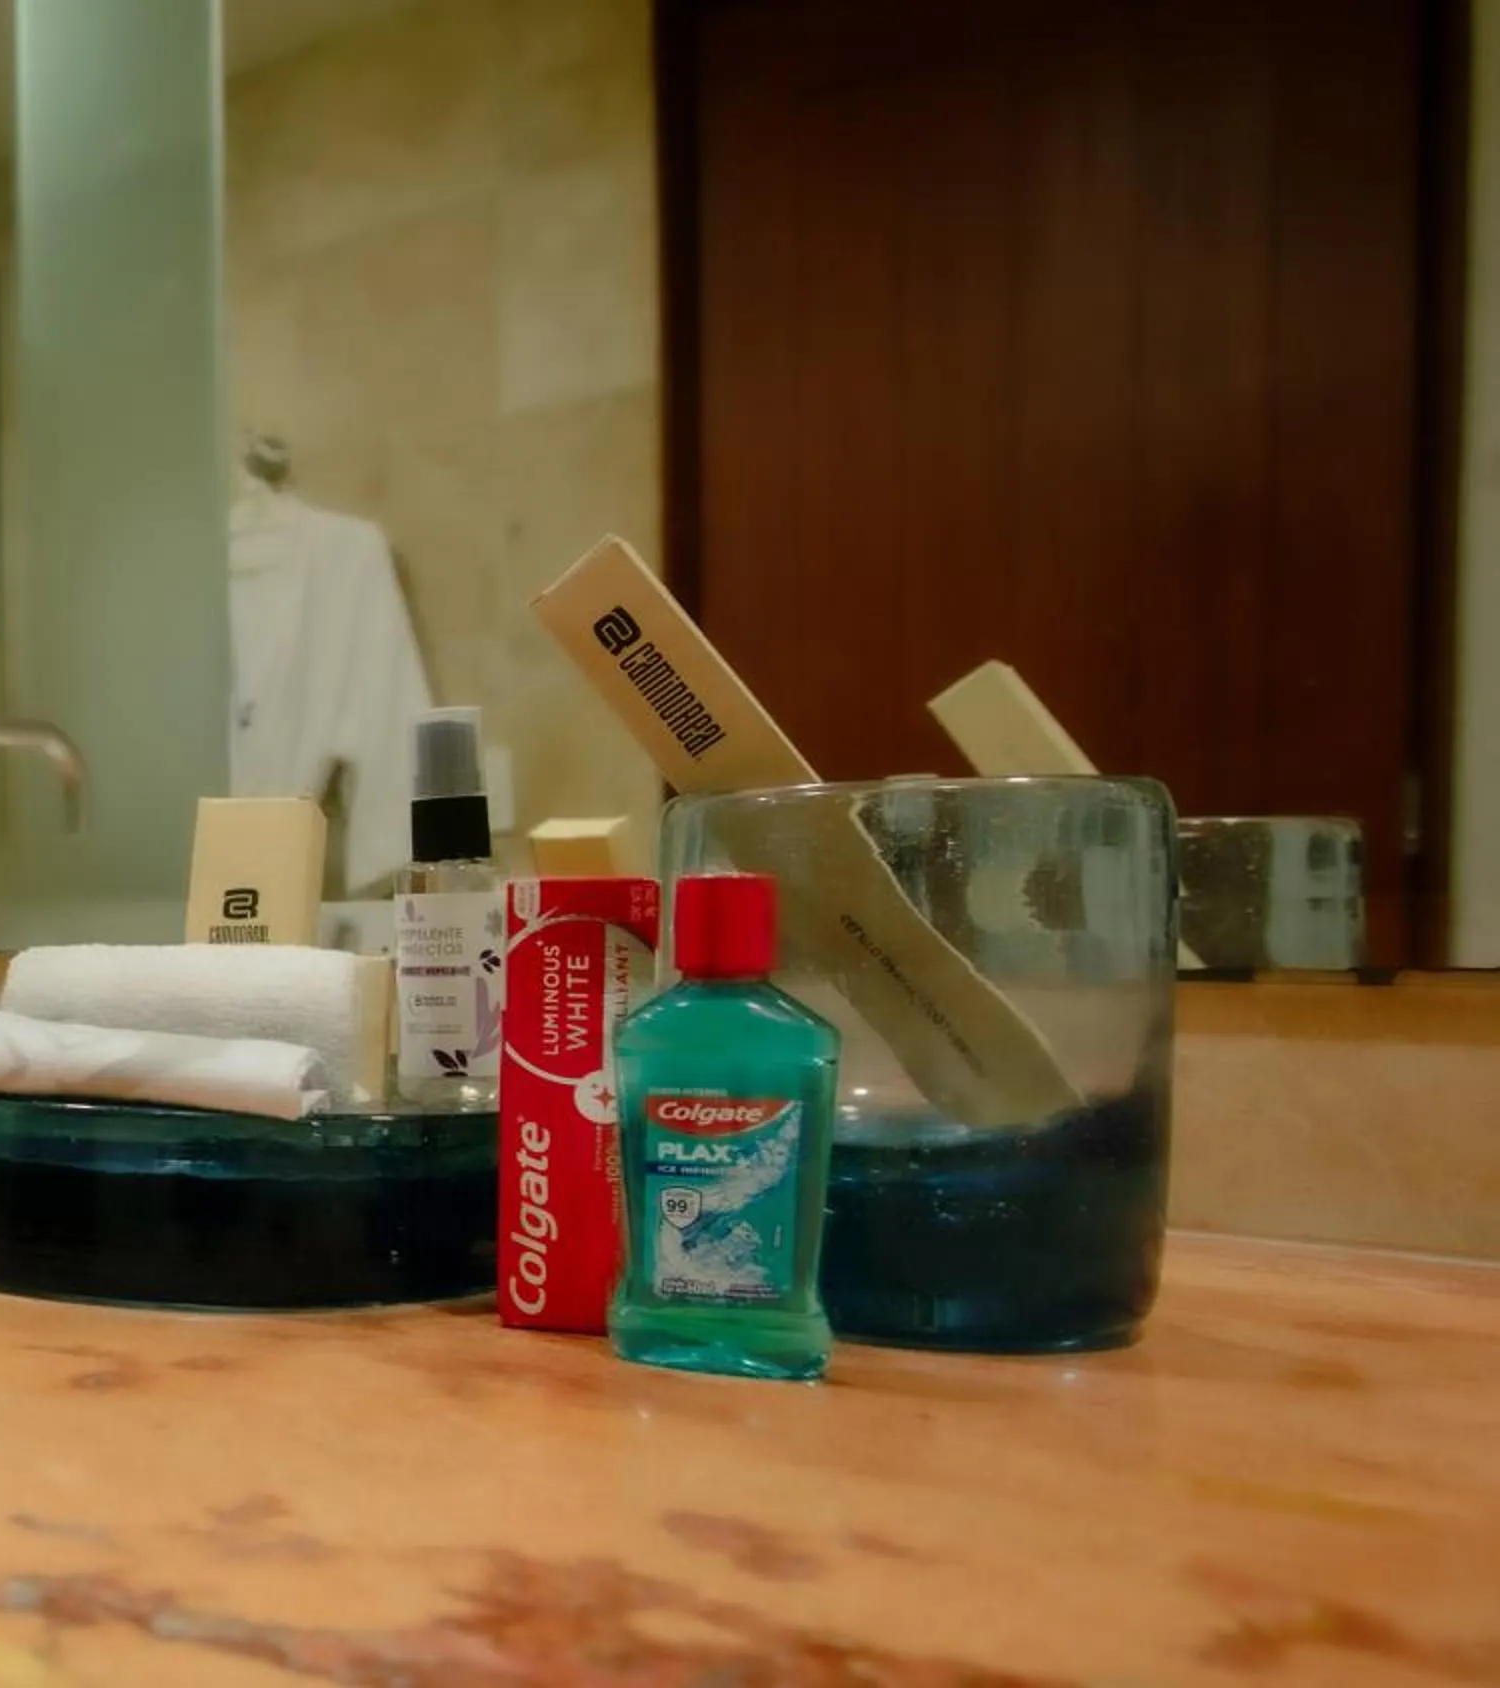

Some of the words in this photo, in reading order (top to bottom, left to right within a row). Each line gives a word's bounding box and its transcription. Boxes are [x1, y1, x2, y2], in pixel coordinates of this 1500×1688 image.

[543, 945, 561, 1056] LUMINOUS
[566, 954, 590, 1051] WHITE
[614, 944, 630, 1017] LLIANT
[656, 1141, 733, 1163] PLAX
[657, 1101, 764, 1126] Colgate
[509, 1121, 559, 1316] Colgate
